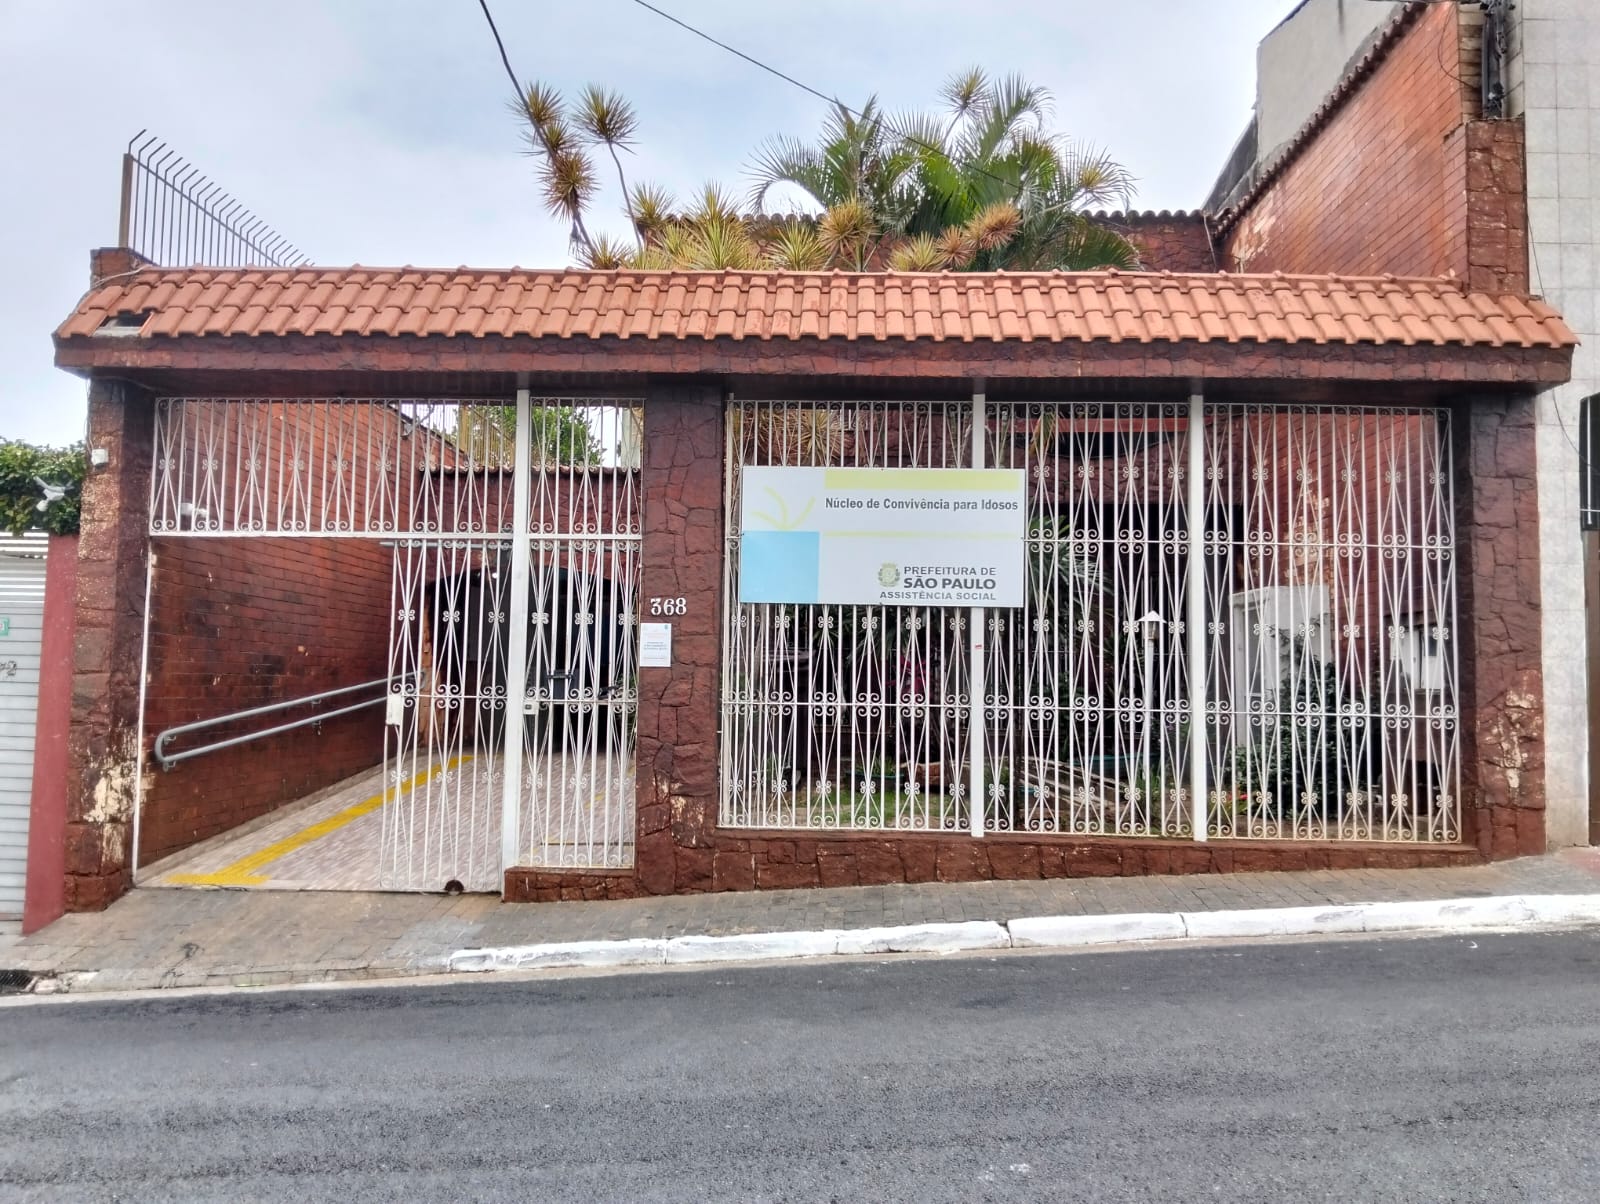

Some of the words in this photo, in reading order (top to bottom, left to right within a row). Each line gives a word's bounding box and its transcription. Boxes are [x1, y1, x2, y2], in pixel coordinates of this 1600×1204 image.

[825, 497, 863, 509] Núcleo
[866, 498, 880, 509] de
[883, 498, 950, 510] Convivência
[953, 501, 978, 512] para
[981, 499, 1018, 510] Idosos
[904, 566, 977, 576] PREFEITURA
[980, 567, 997, 576] DE
[903, 575, 938, 589] SÃO
[942, 578, 996, 590] PAULO
[879, 590, 953, 600] ASSISTÊNCIA
[956, 592, 997, 601] SOCIAL
[650, 597, 687, 616] 368
